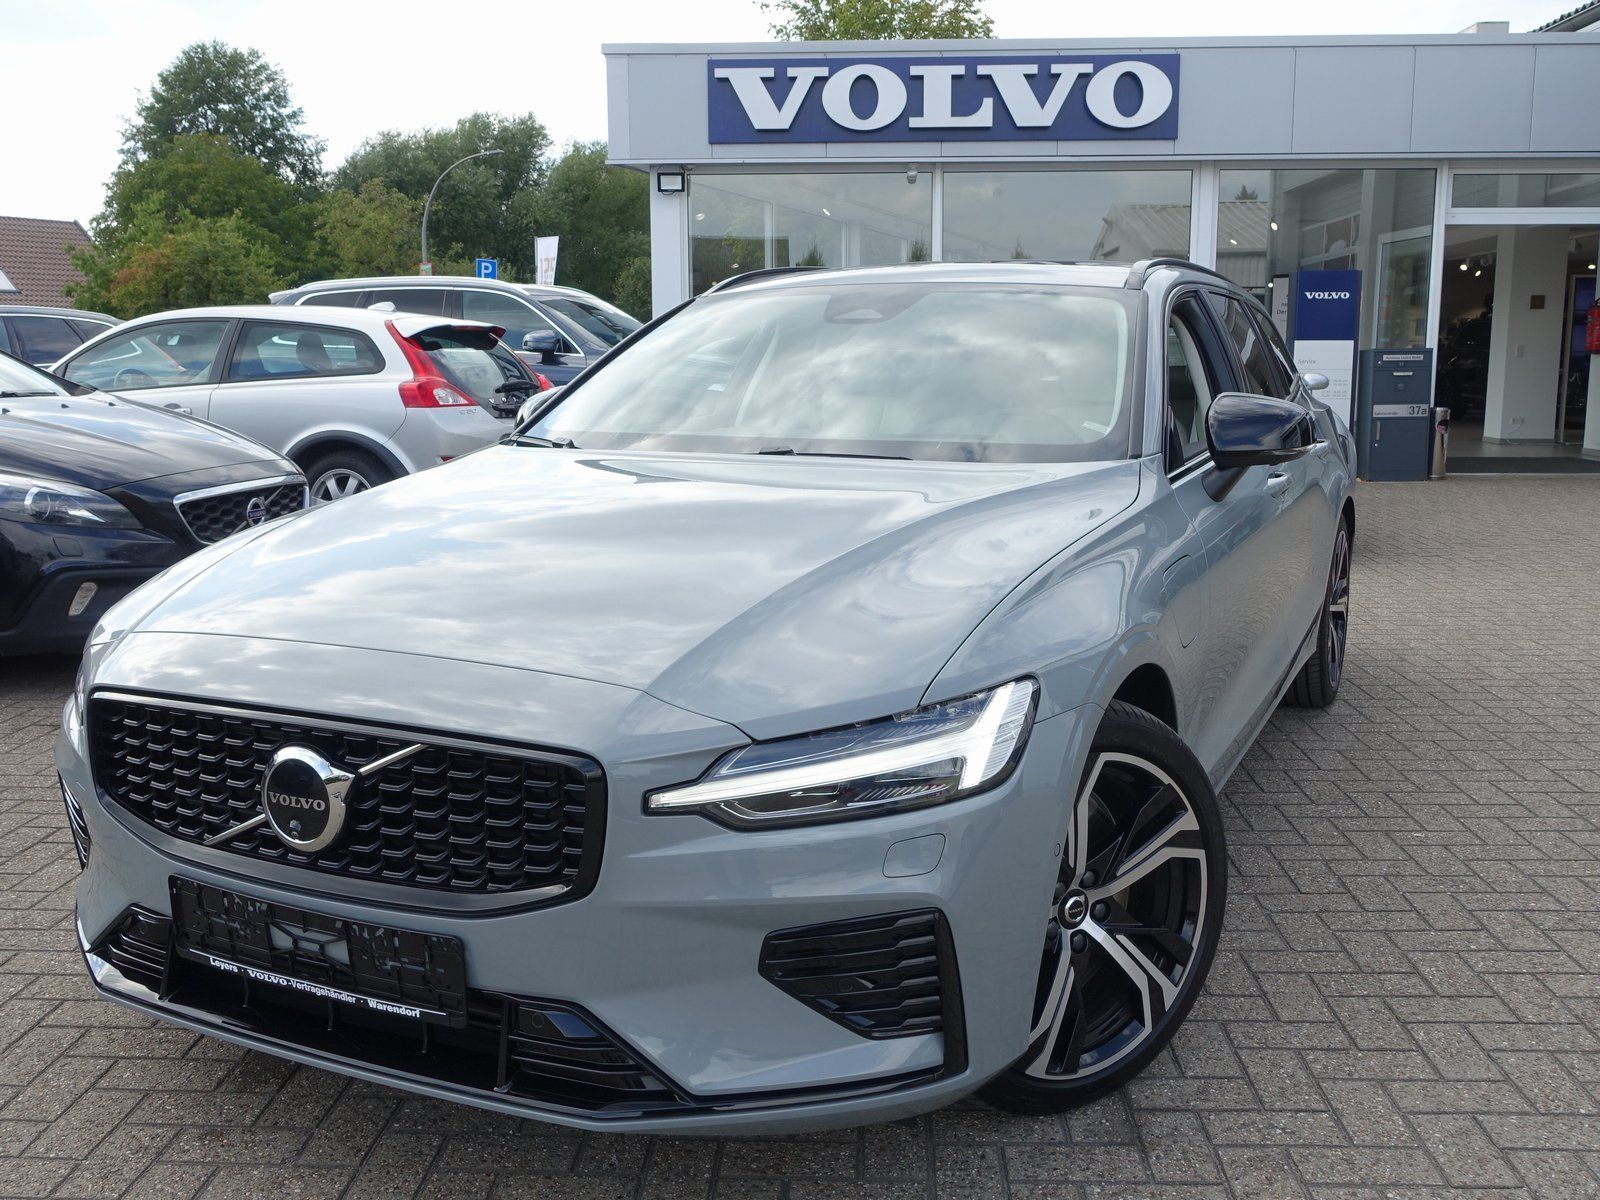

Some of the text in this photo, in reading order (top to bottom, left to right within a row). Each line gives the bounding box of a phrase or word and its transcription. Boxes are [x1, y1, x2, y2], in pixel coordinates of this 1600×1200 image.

[714, 60, 1173, 131] VOLVO
[481, 262, 492, 278] P
[1304, 291, 1350, 300] VOLVO
[1409, 405, 1427, 415] 37a
[268, 791, 326, 811] VOLVO
[209, 957, 239, 973] Leyers
[367, 999, 421, 1018] Warendorf
